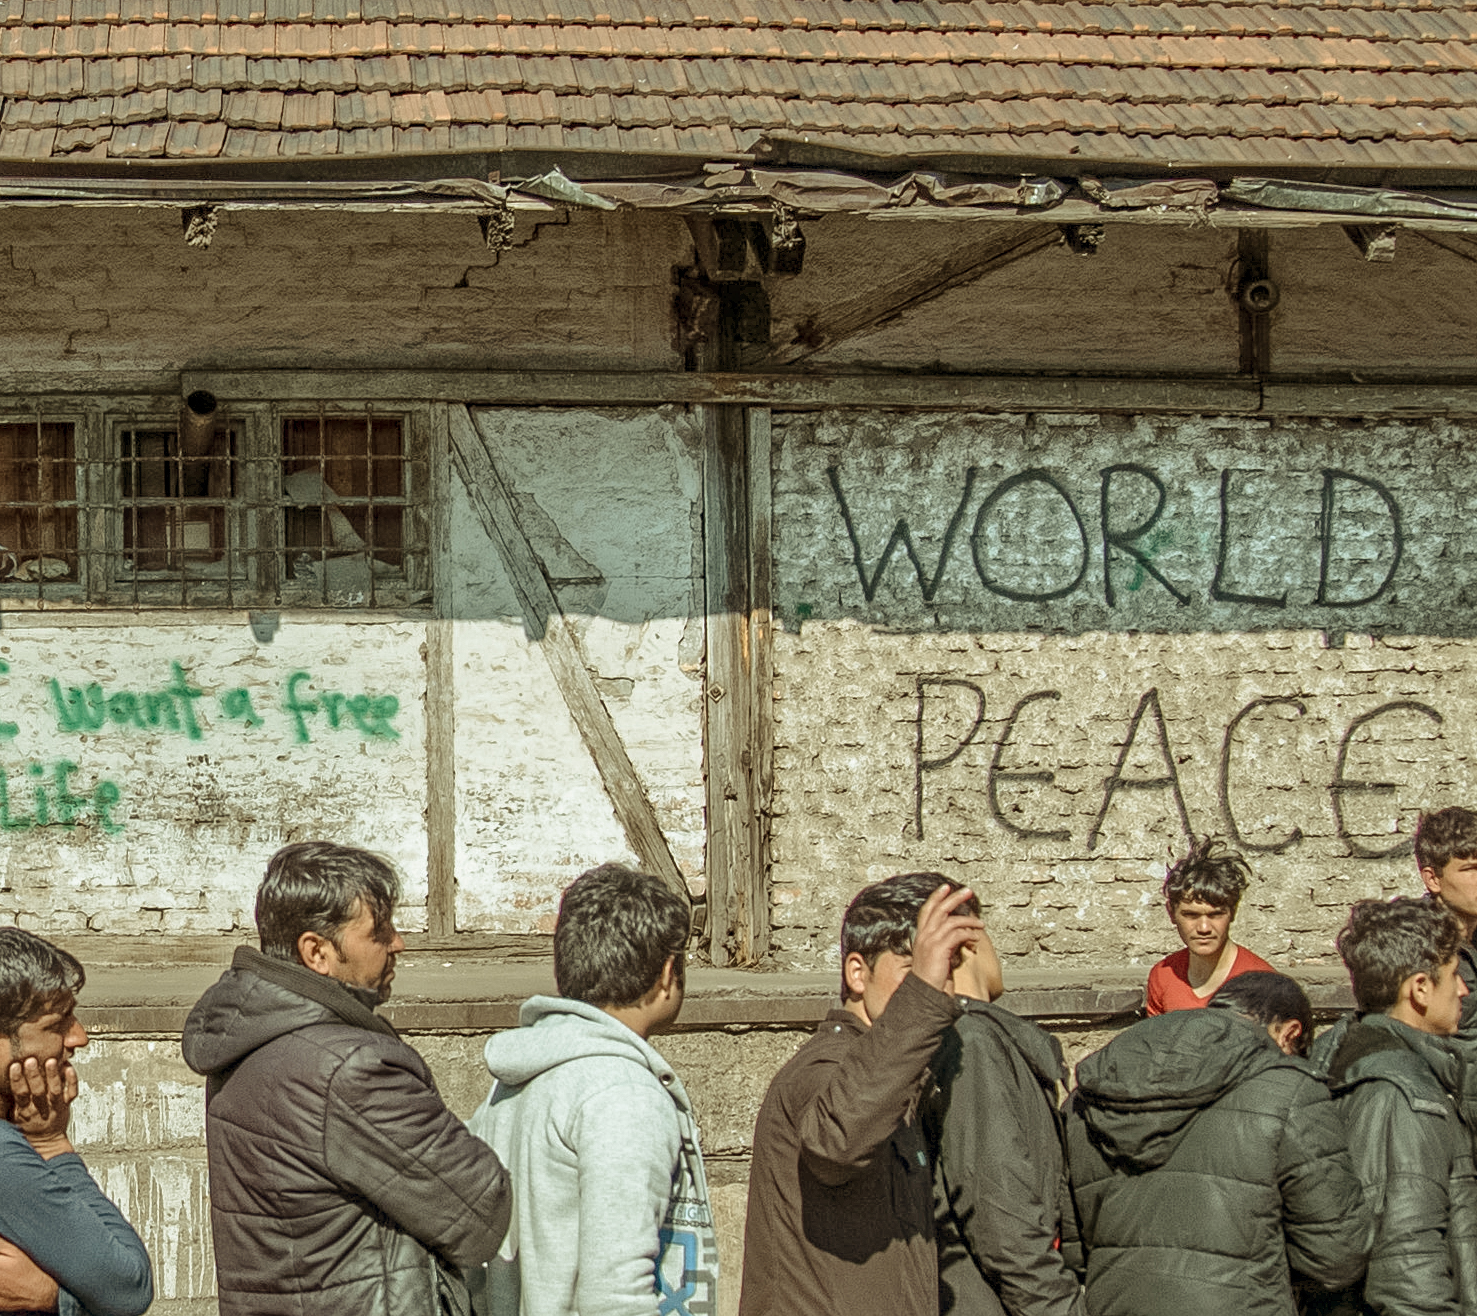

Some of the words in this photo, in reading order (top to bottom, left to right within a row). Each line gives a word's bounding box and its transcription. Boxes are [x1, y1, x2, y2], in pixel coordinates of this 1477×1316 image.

[827, 464, 1402, 607] WORLD
[219, 688, 264, 728] a
[284, 672, 401, 743] free
